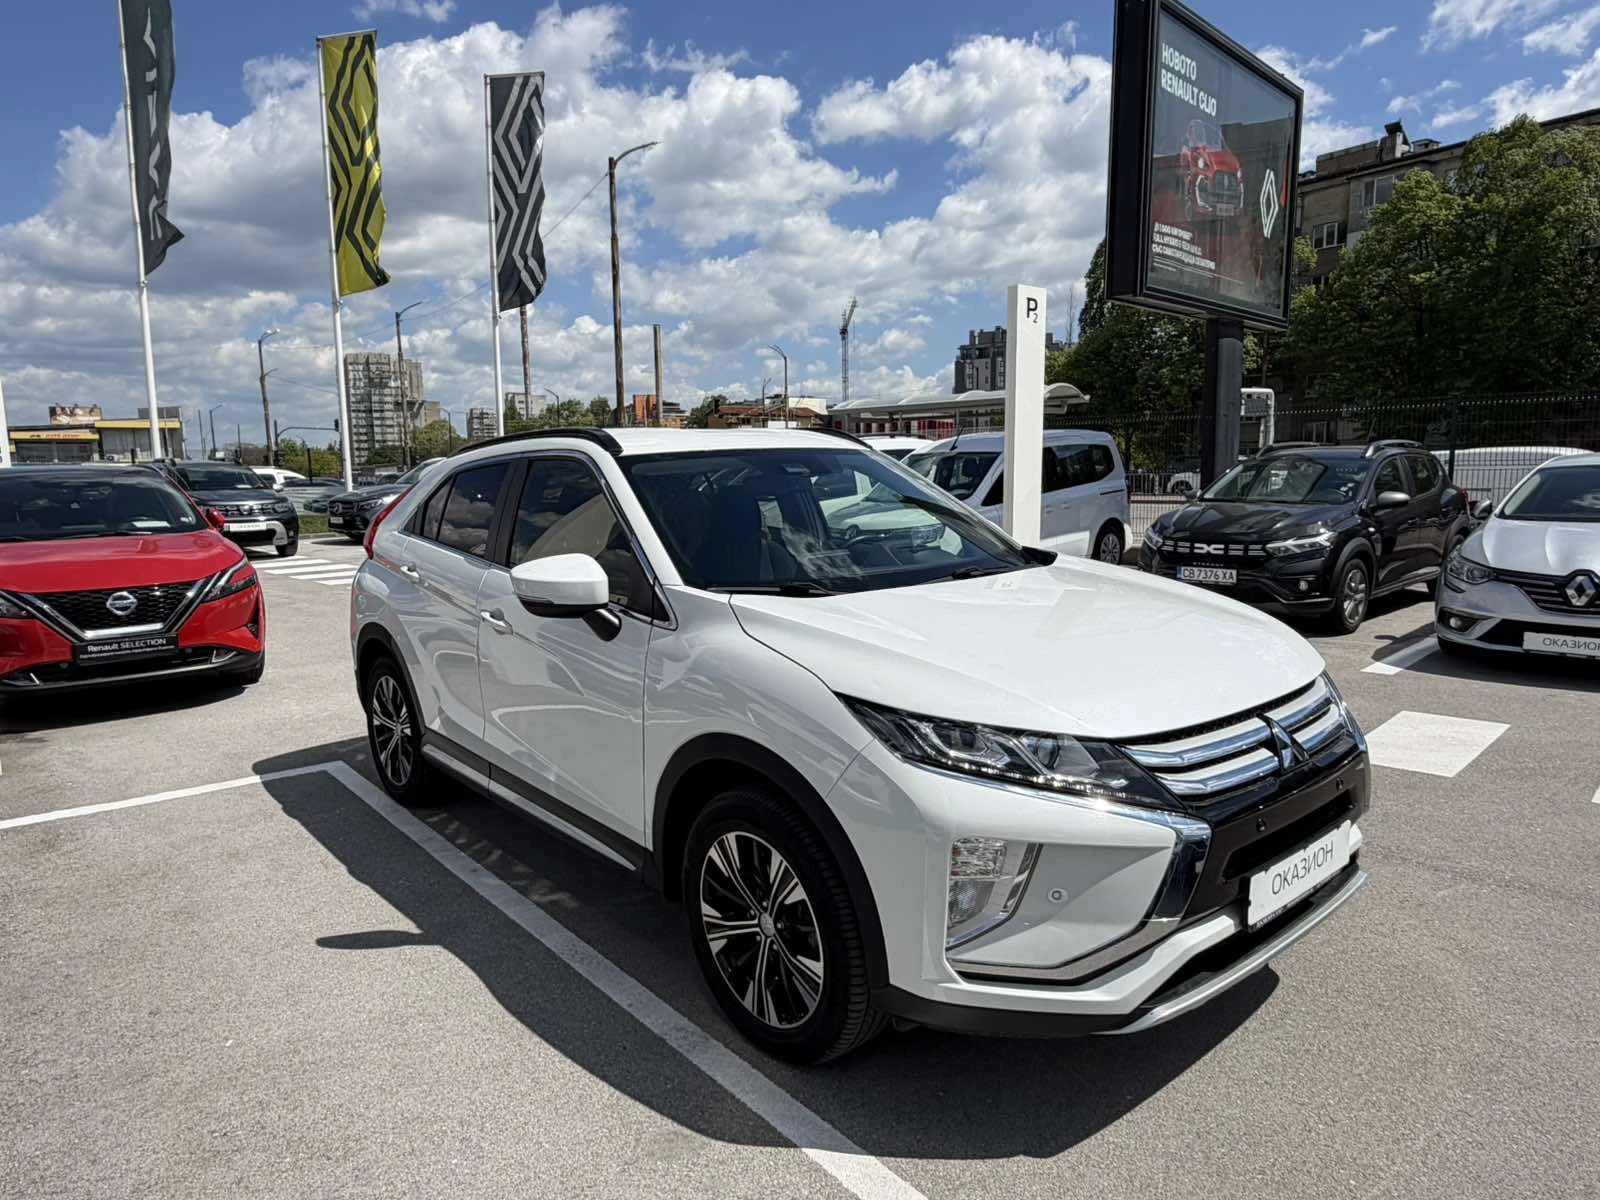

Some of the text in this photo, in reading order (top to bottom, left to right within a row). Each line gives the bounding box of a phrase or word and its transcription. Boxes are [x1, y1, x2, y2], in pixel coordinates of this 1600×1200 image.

[1162, 43, 1197, 80] НОВОТО
[1161, 68, 1217, 116] RENAULT CLIO
[88, 643, 120, 653] Renault
[120, 638, 167, 650] SELECTION
[1542, 637, 1600, 651] ОКАЗИО
[1271, 839, 1334, 895] ОКАЗИОН
